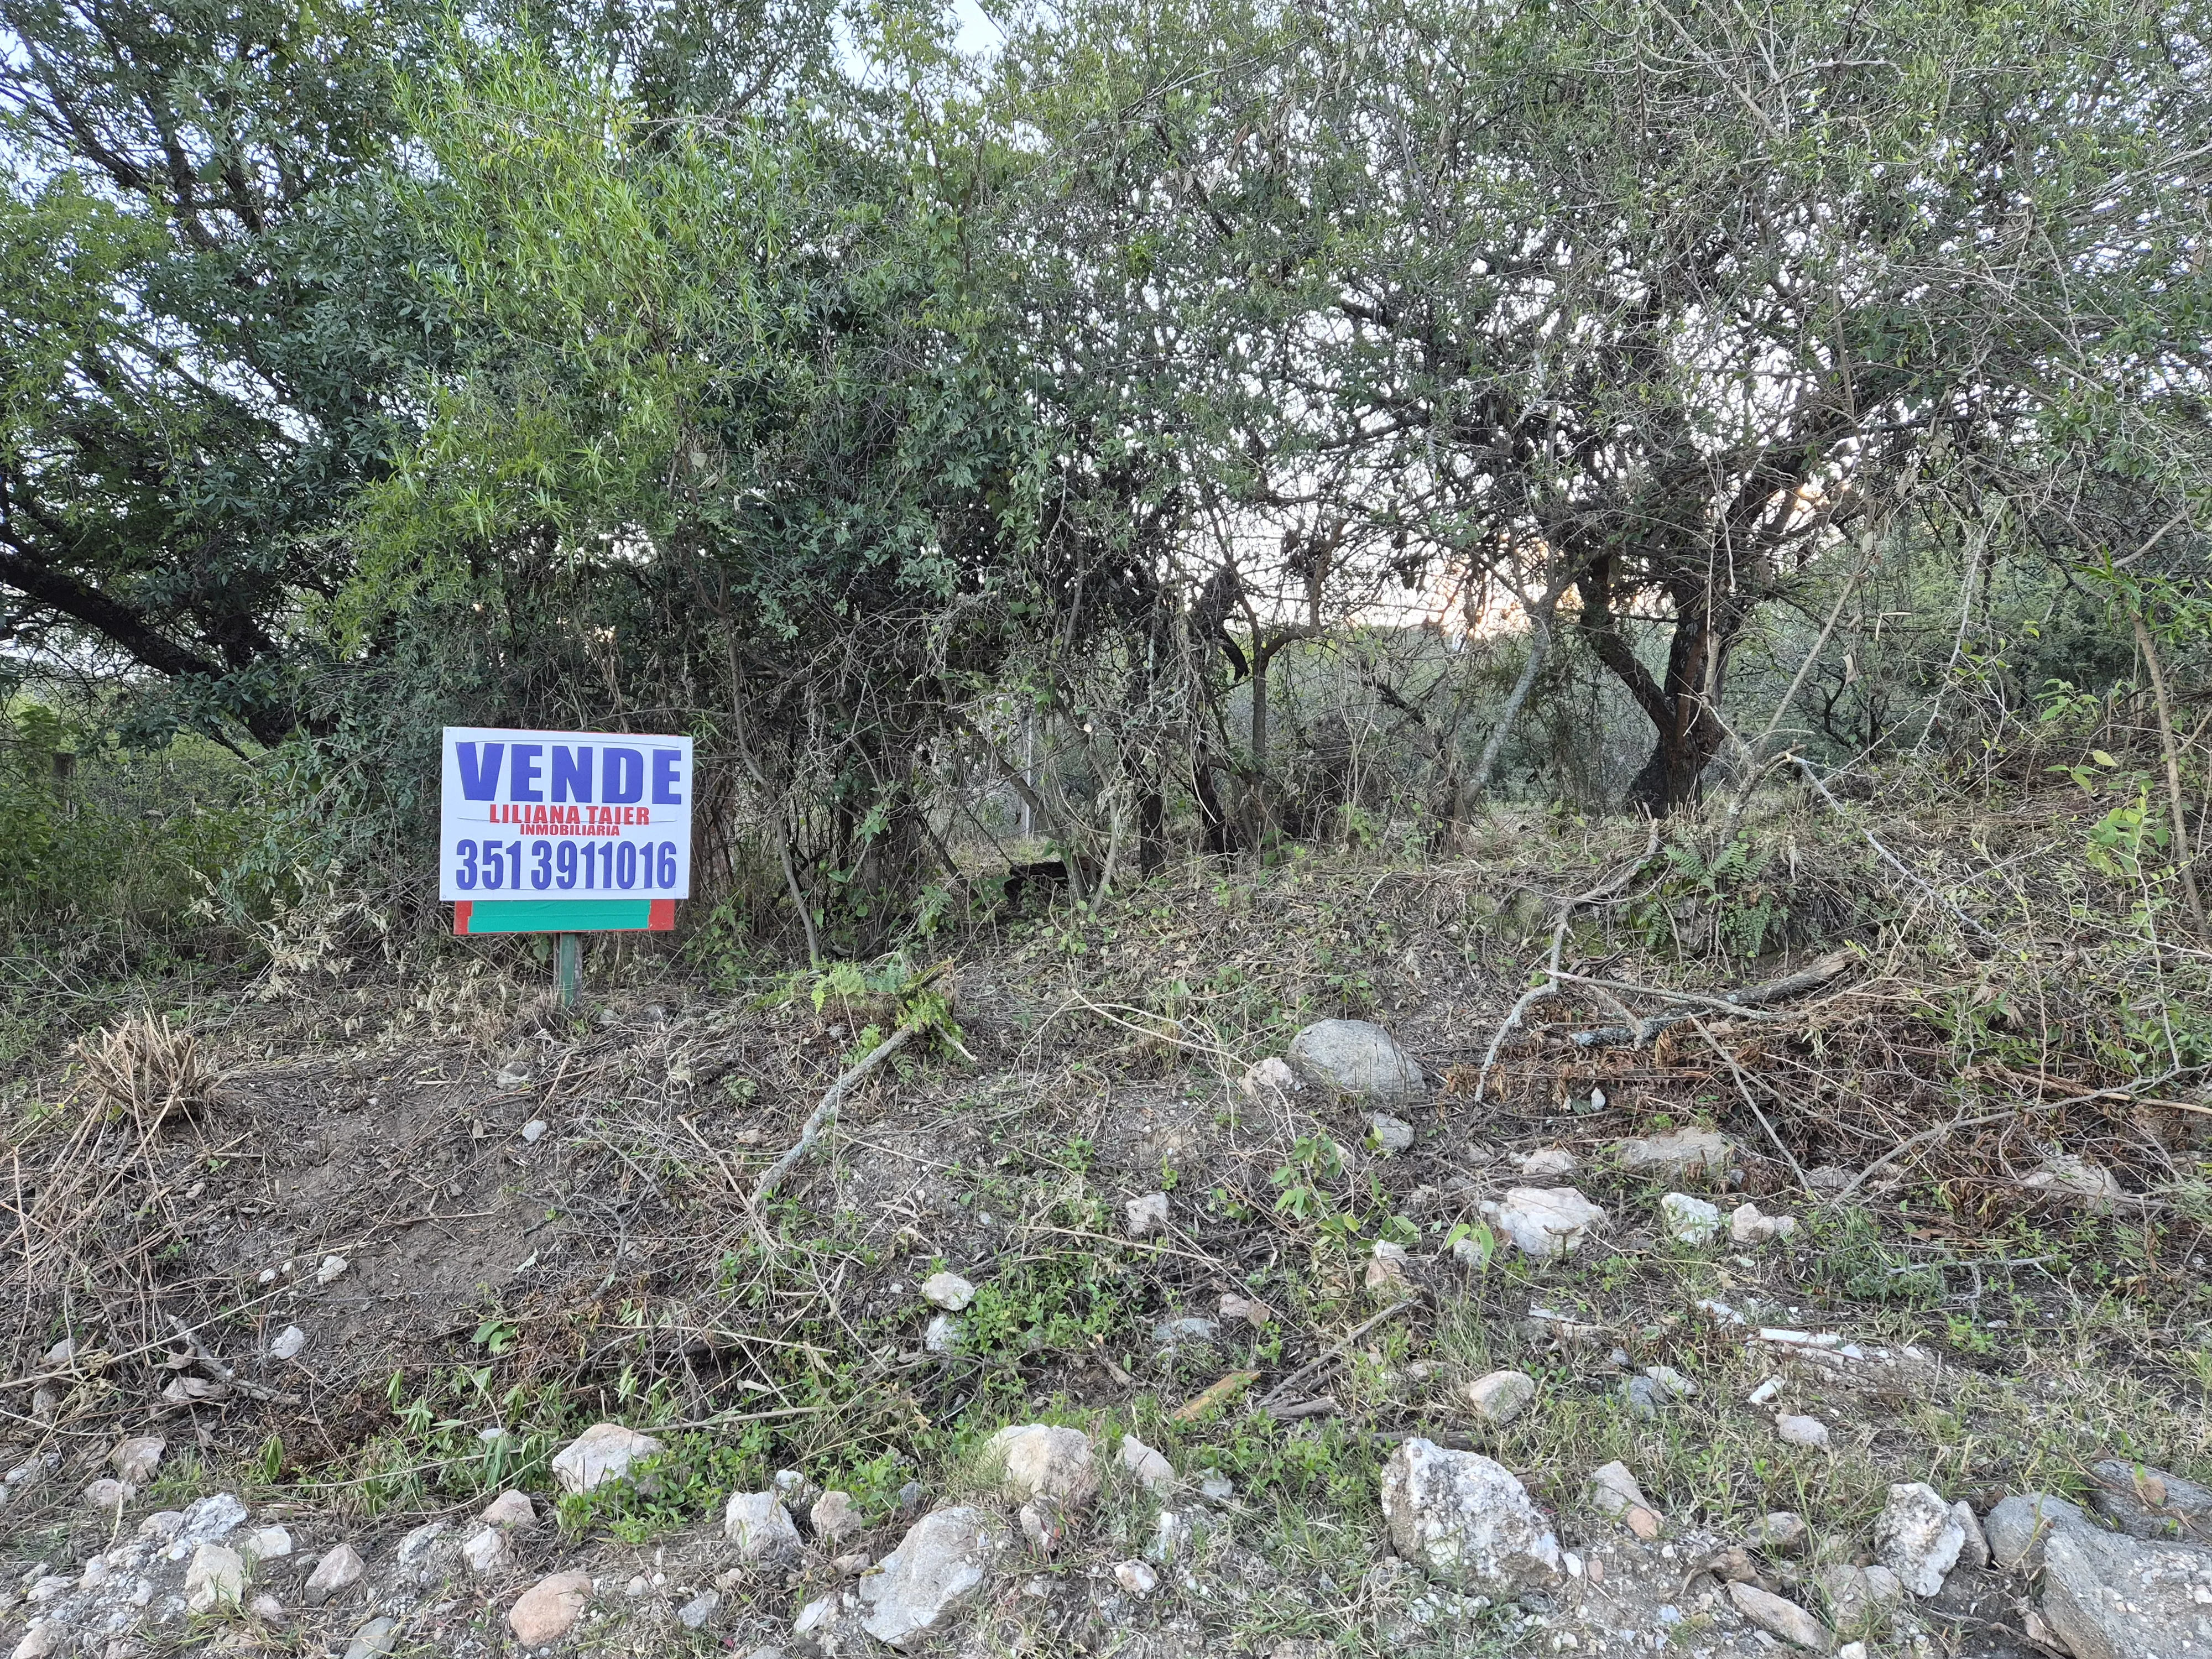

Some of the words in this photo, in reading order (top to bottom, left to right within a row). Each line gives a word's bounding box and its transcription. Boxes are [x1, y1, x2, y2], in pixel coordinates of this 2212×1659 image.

[455, 742, 681, 805] VENDE
[489, 804, 580, 823] LILIANA
[586, 806, 649, 825] TAIER
[520, 824, 620, 836] INMOBILIARIA
